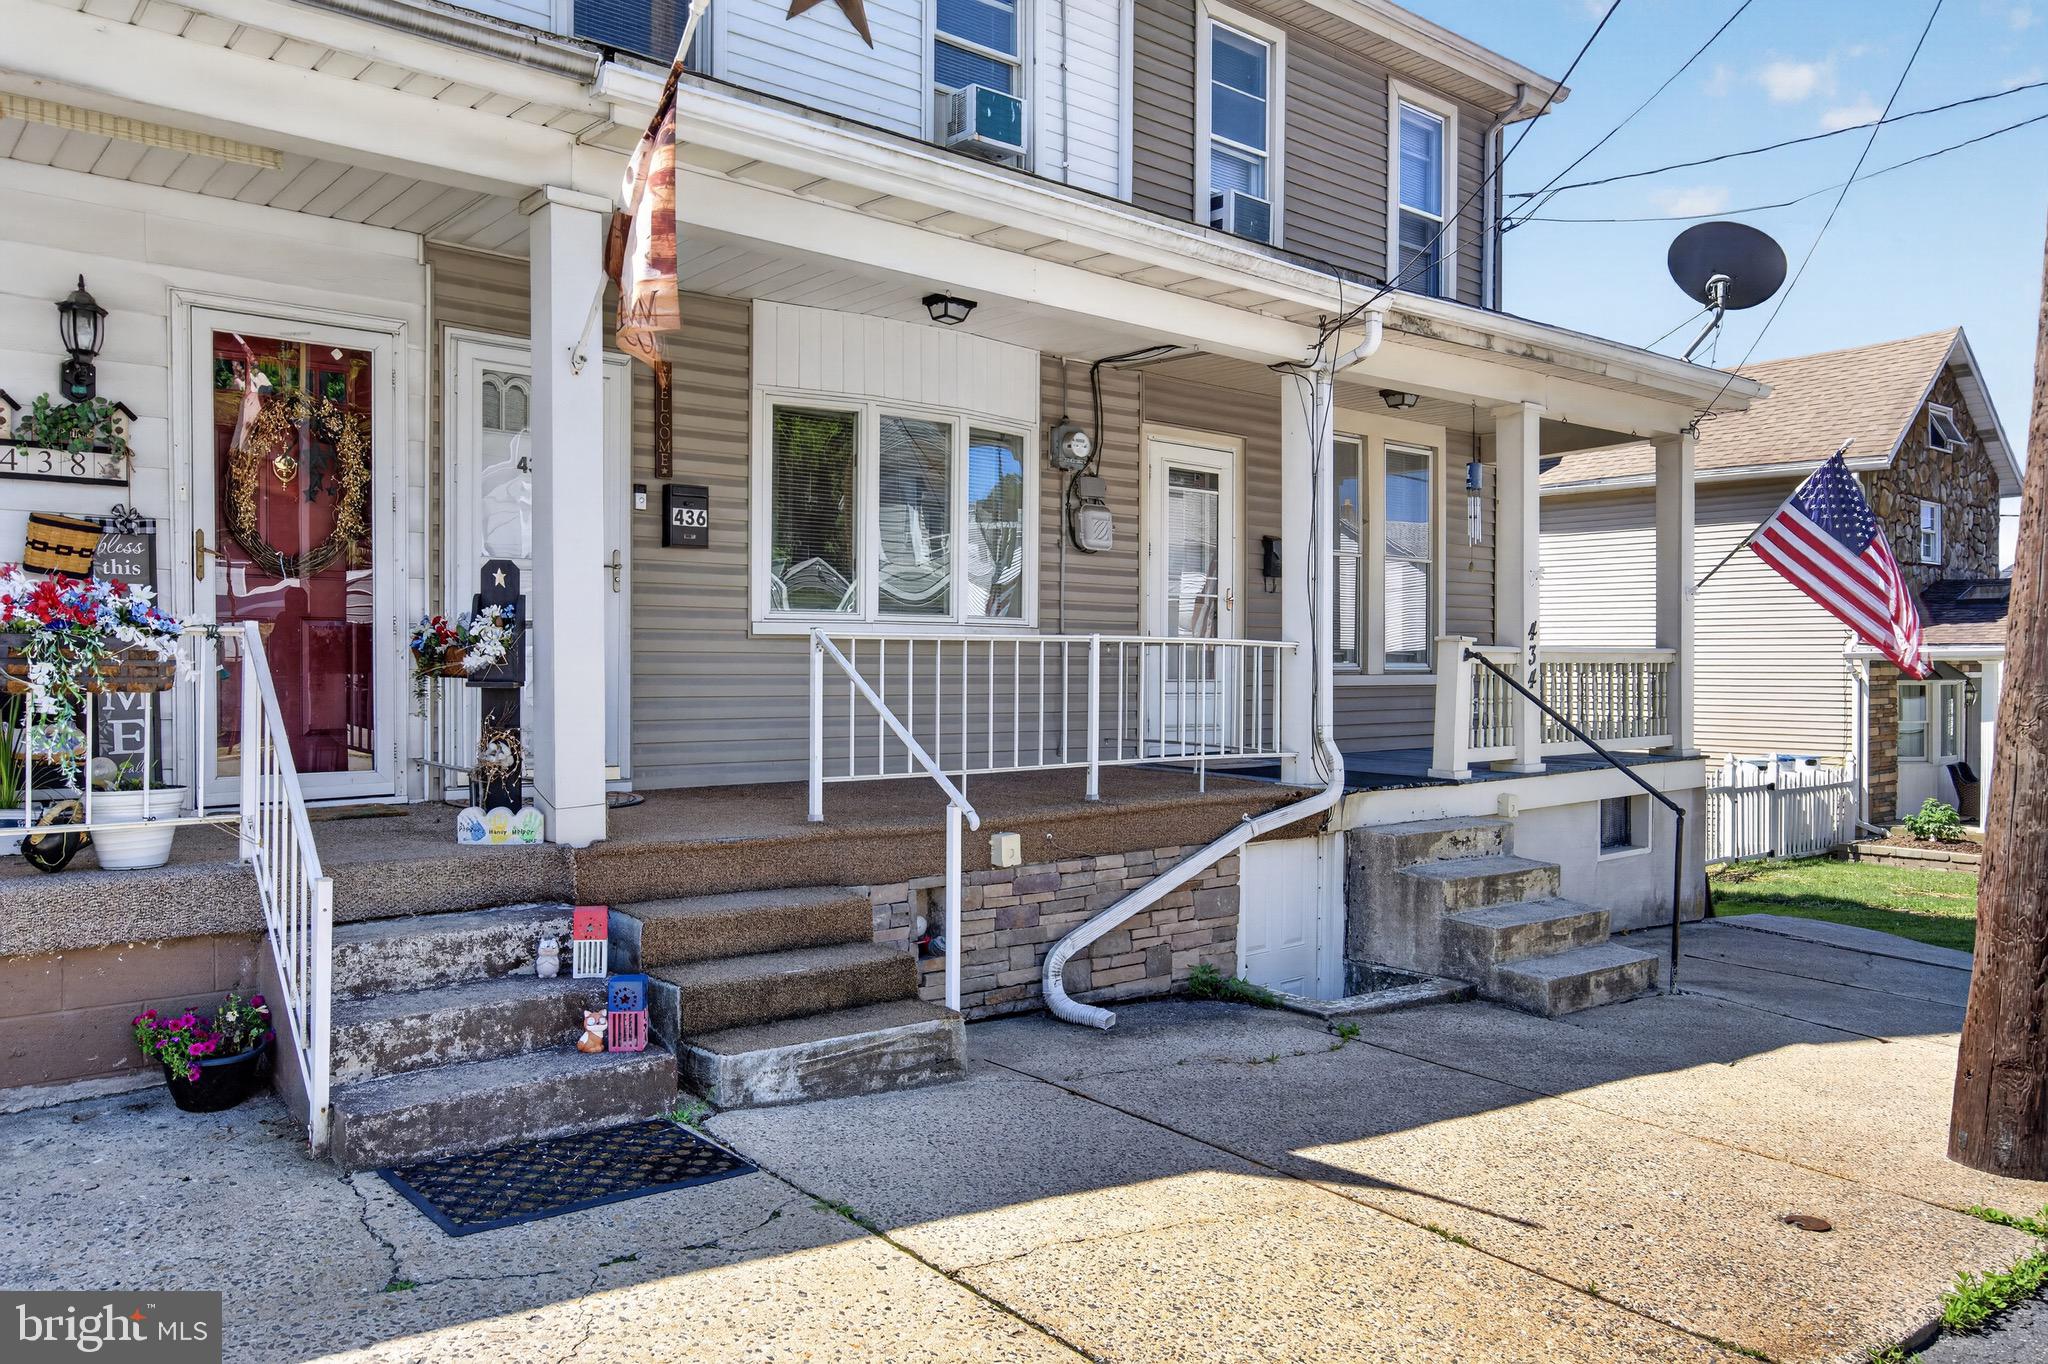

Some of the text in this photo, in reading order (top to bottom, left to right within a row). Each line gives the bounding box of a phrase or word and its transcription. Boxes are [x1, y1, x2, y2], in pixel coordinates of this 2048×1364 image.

[0, 448, 86, 476] 438
[673, 509, 706, 527] 436
[97, 533, 145, 557] bless
[102, 558, 141, 576] this
[1527, 620, 1538, 689] 434
